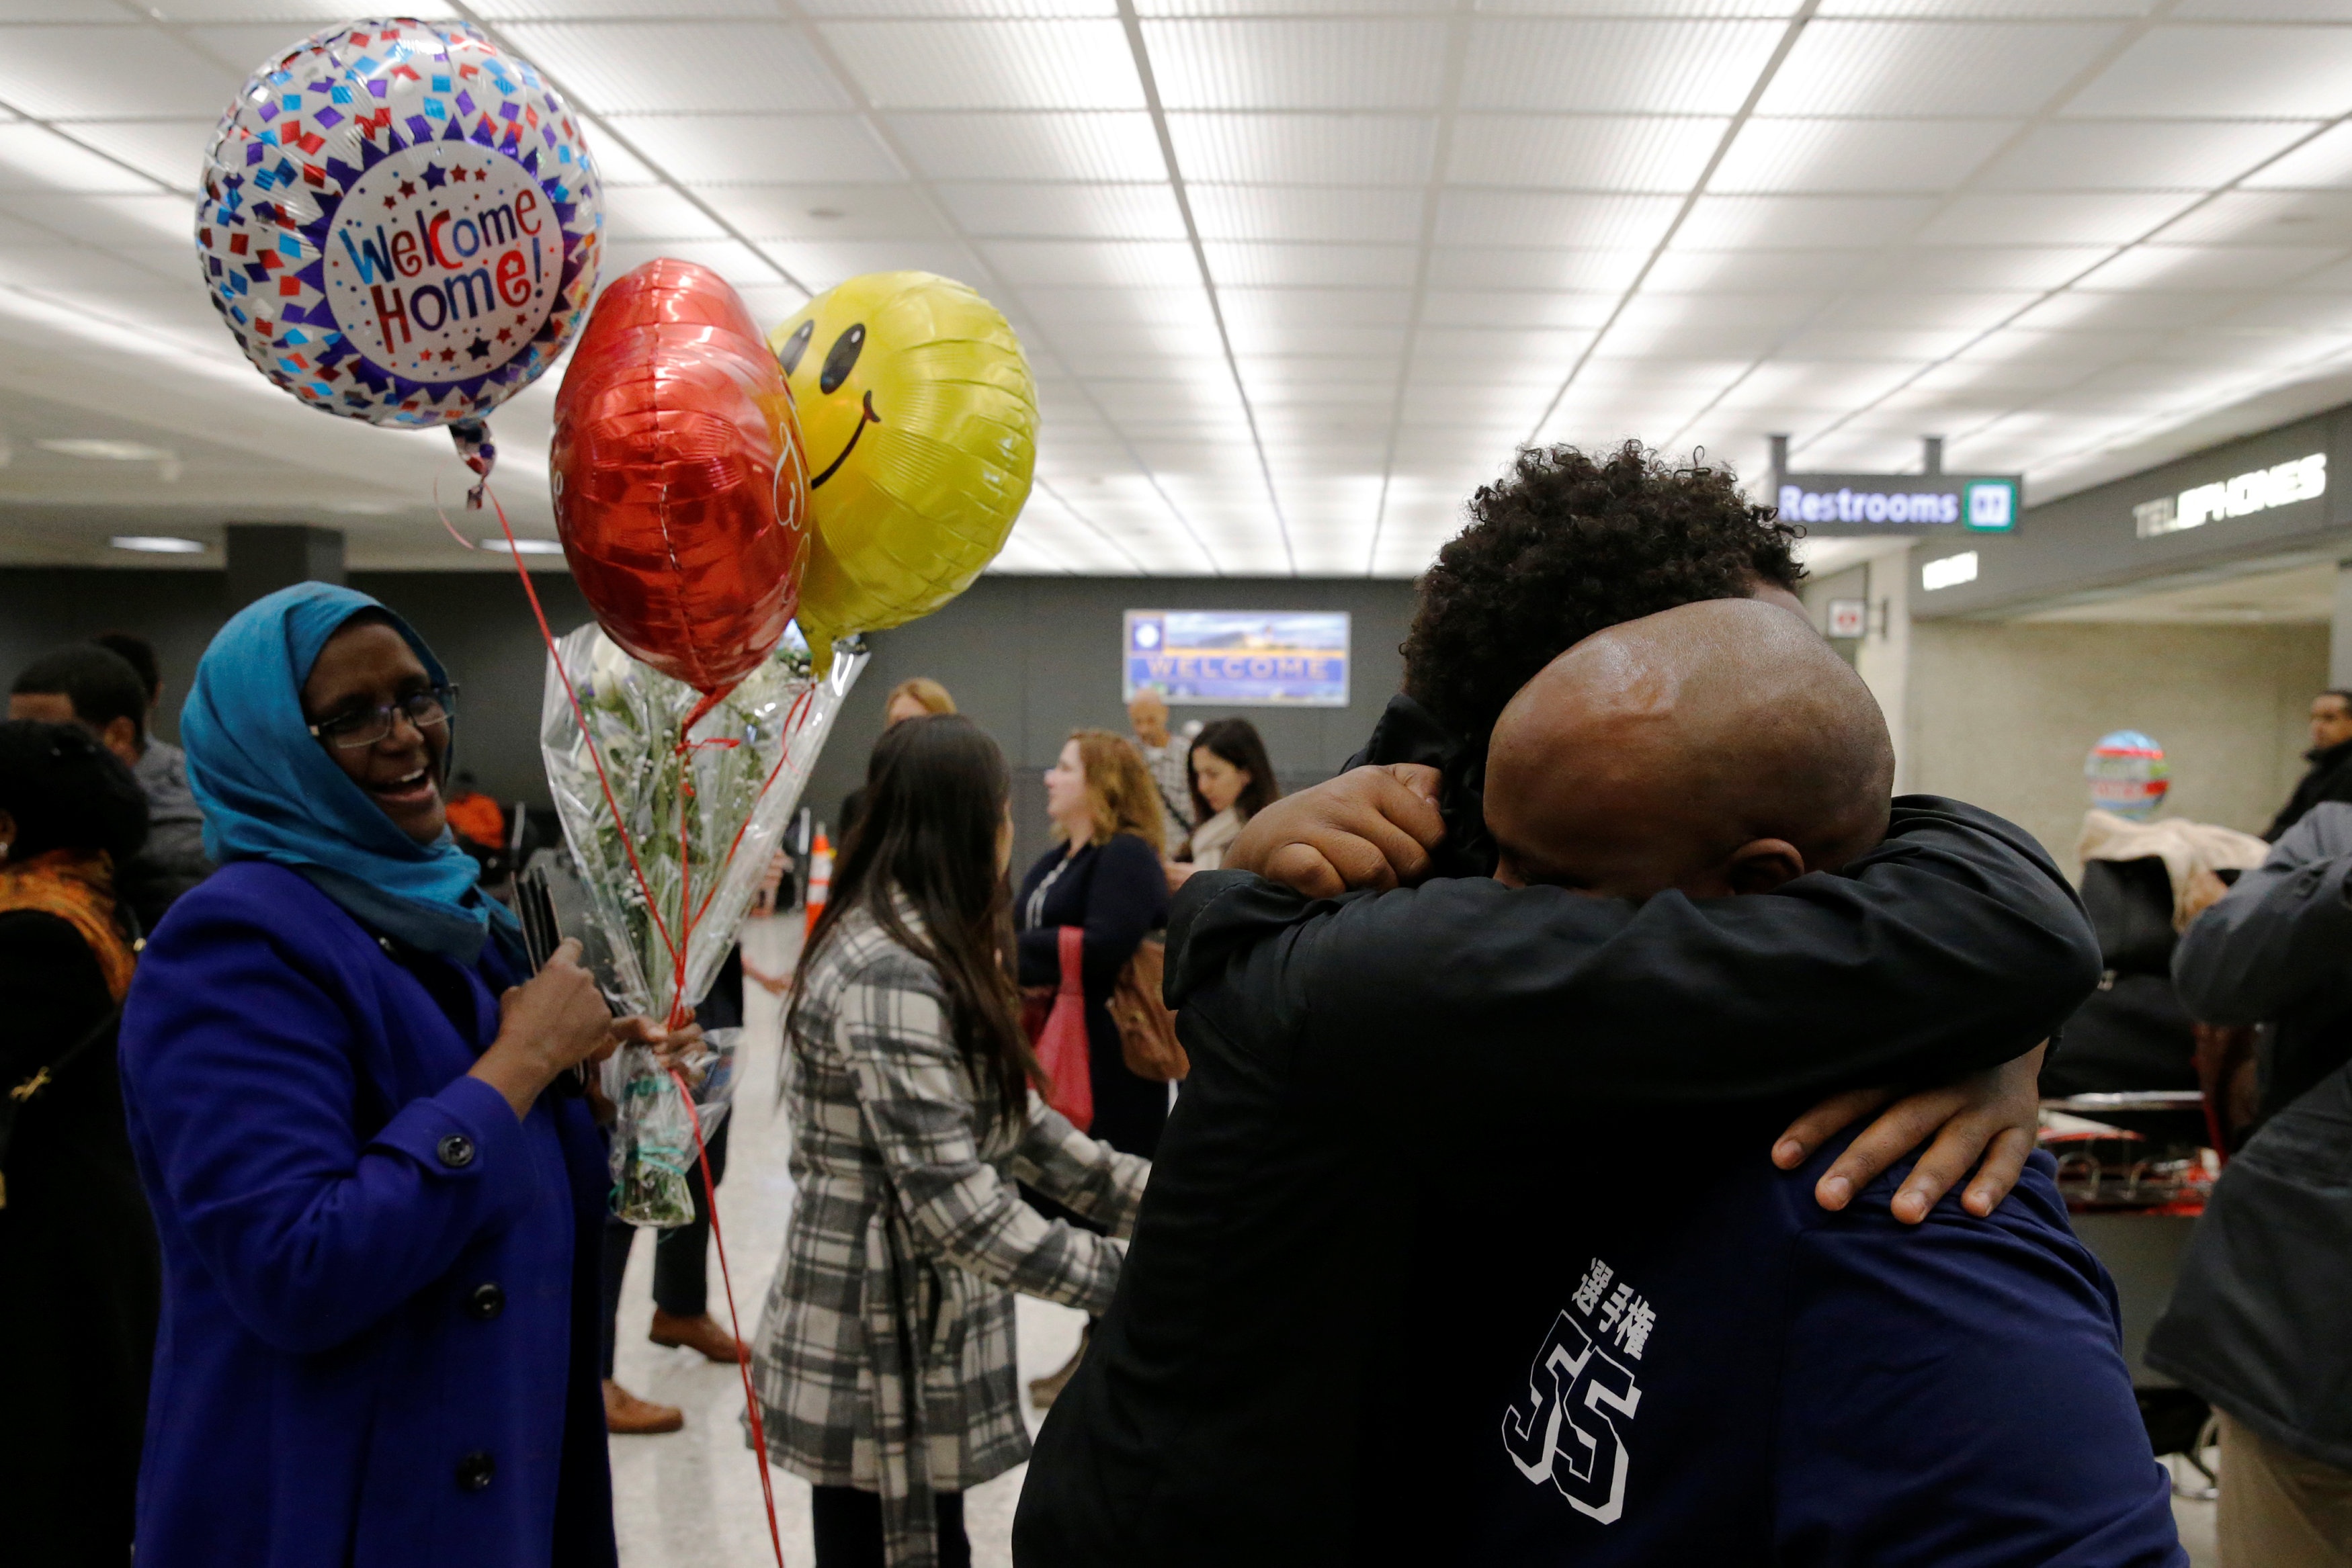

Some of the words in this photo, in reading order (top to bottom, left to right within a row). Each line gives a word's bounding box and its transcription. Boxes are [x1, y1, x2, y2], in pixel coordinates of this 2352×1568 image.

[370, 236, 544, 354] Home!
[1779, 485, 1958, 524] Restrooms
[2133, 453, 2326, 538] TELEPHONES
[1147, 656, 1329, 679] WELCOME
[1572, 1257, 1656, 1361] 選手権
